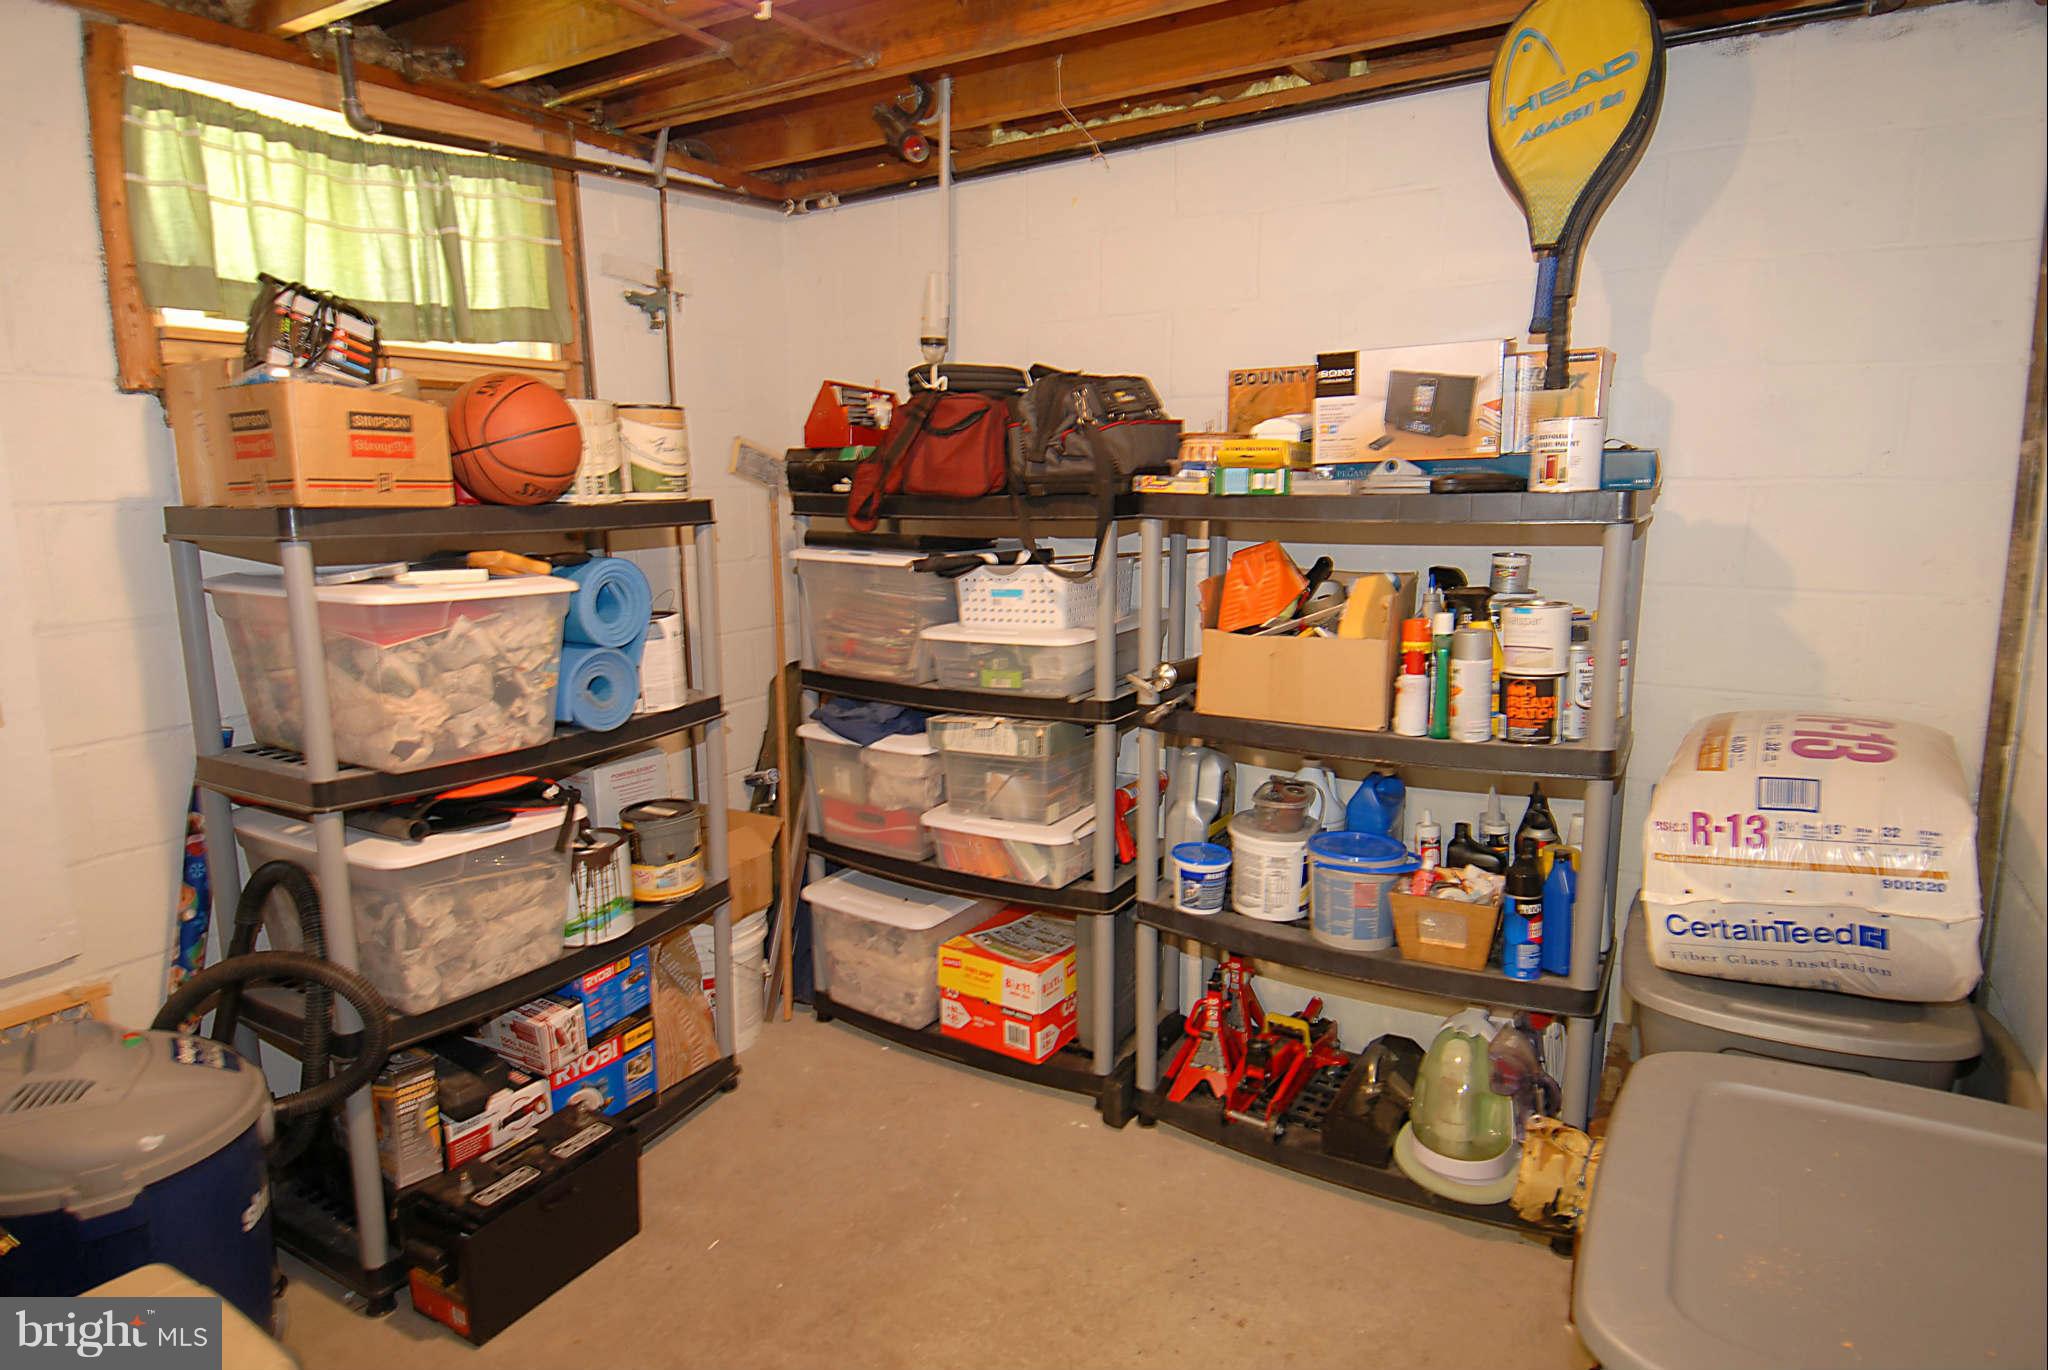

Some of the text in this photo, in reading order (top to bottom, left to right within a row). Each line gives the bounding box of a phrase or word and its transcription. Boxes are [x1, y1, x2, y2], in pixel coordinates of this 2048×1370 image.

[1508, 50, 1640, 123] HEAD
[1233, 368, 1311, 387] BOUNTY
[1318, 368, 1355, 379] SONY
[350, 414, 412, 430] SIMPSON
[1507, 696, 1557, 708] READY
[1507, 707, 1555, 719] PATCH
[1691, 811, 1770, 850] R-13
[1666, 914, 1858, 946] CertainTeed
[583, 963, 617, 989] RYOBI
[1669, 949, 1893, 977] Fiber Glass Insulation
[555, 1039, 618, 1086] RYOBI
